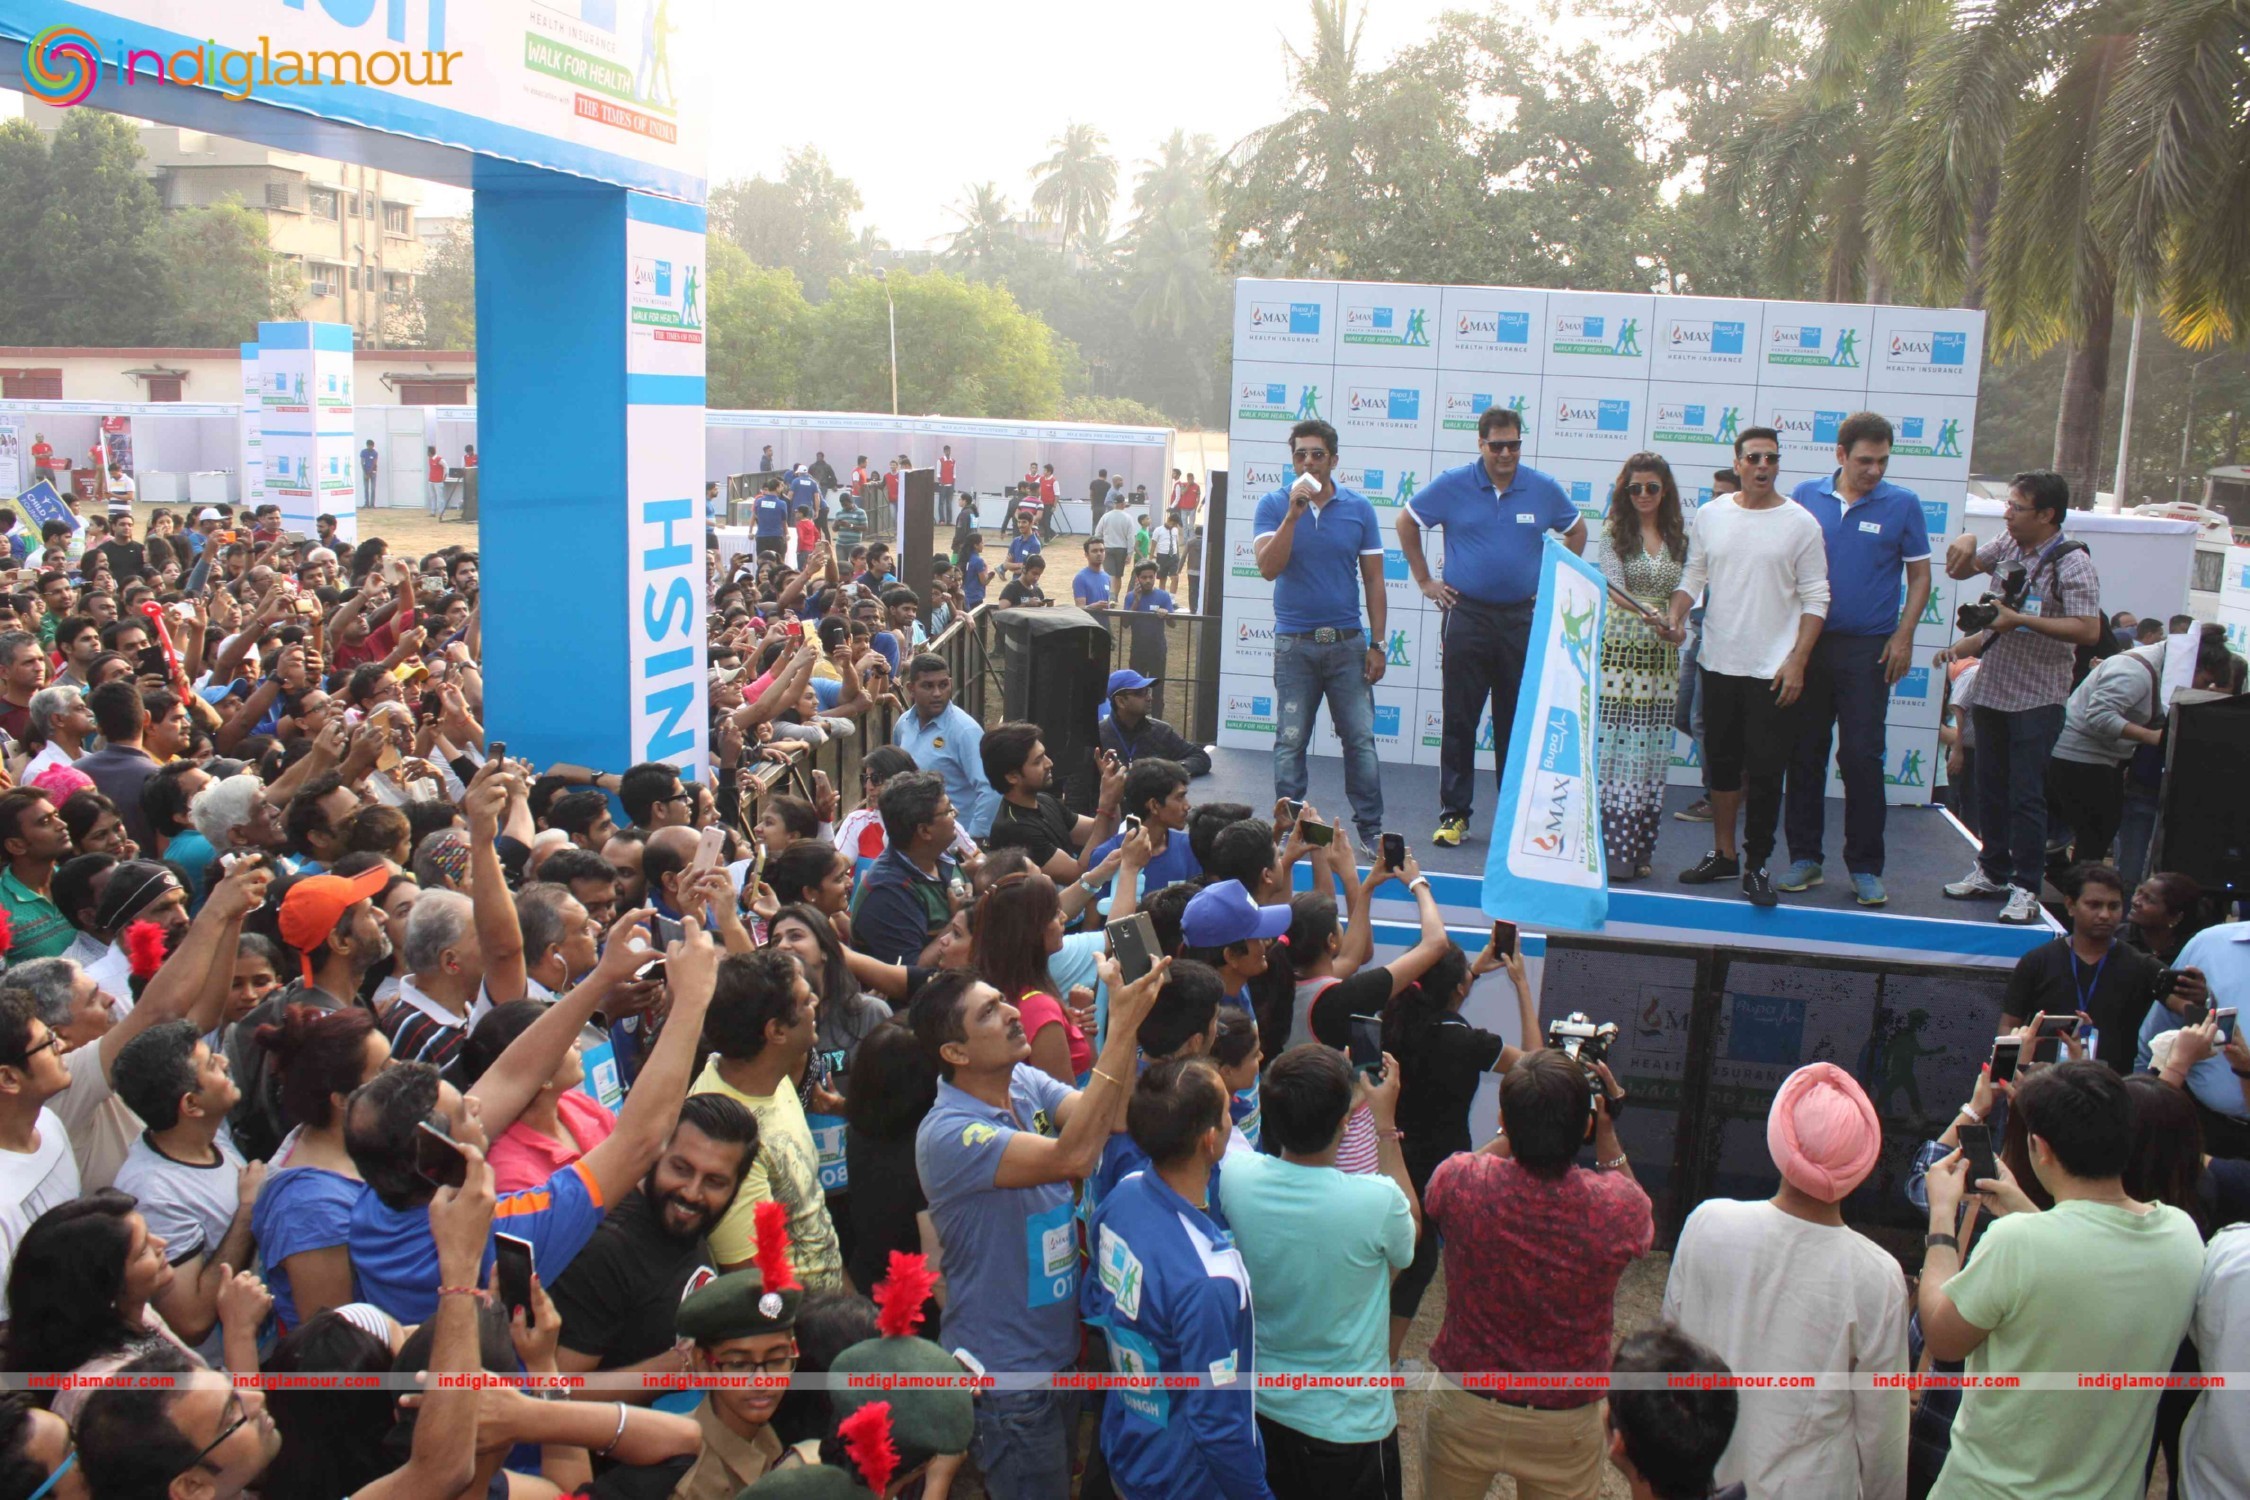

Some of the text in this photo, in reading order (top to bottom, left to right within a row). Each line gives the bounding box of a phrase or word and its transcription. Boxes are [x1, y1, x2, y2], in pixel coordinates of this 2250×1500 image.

[530, 11, 617, 54] HEALTH INSURANCE
[528, 41, 631, 94] WALK FOR HEALTH
[578, 98, 675, 142] THE TIMES OF INDIA
[640, 271, 655, 283] MAX
[1262, 304, 1308, 323] MAX Bupa
[1355, 313, 1372, 321] MAX
[1469, 313, 1517, 332] MAX Bupa
[1565, 322, 1582, 330] MAX
[1682, 323, 1732, 342] MAX Bupa
[1781, 332, 1799, 341] MAX
[1279, 336, 1320, 344] INSURANCE
[1377, 336, 1401, 344] HEALTH
[1901, 334, 1953, 353] MAX Bupa
[1486, 345, 1527, 353] INSURANCE
[1587, 346, 1612, 354] HEALTH
[1699, 355, 1743, 363] INSURANCE
[1770, 355, 1788, 363] WALK
[1803, 356, 1829, 364] HEALTH
[1918, 366, 1963, 374] INSURANCE
[1361, 390, 1407, 409] MAX Bupa
[1454, 399, 1471, 407] MAX
[1240, 411, 1258, 419] WALK
[1270, 412, 1295, 420] HEALTH
[1569, 401, 1618, 419] MAX Bupa
[1665, 410, 1683, 419] MAX
[1784, 413, 1834, 431] MAX Bupa
[1585, 432, 1628, 440] INSURANCE
[1674, 433, 1687, 441] FOR
[1688, 434, 1713, 442] HEALTH
[1906, 447, 1931, 455] HEALTH
[1256, 472, 1281, 483] MAX
[27, 493, 46, 516] CHILD
[1682, 498, 1696, 508] AX
[643, 498, 695, 780] NISH
[1249, 628, 1274, 640] MAX
[1257, 723, 1277, 731] HEALT
[1543, 733, 1571, 832] MAX Bupa
[1587, 816, 1596, 866] WALK
[1736, 1001, 1776, 1014] Bupa
[1630, 1058, 1682, 1072] HEALT
[1123, 1392, 1159, 1418] SINGH
